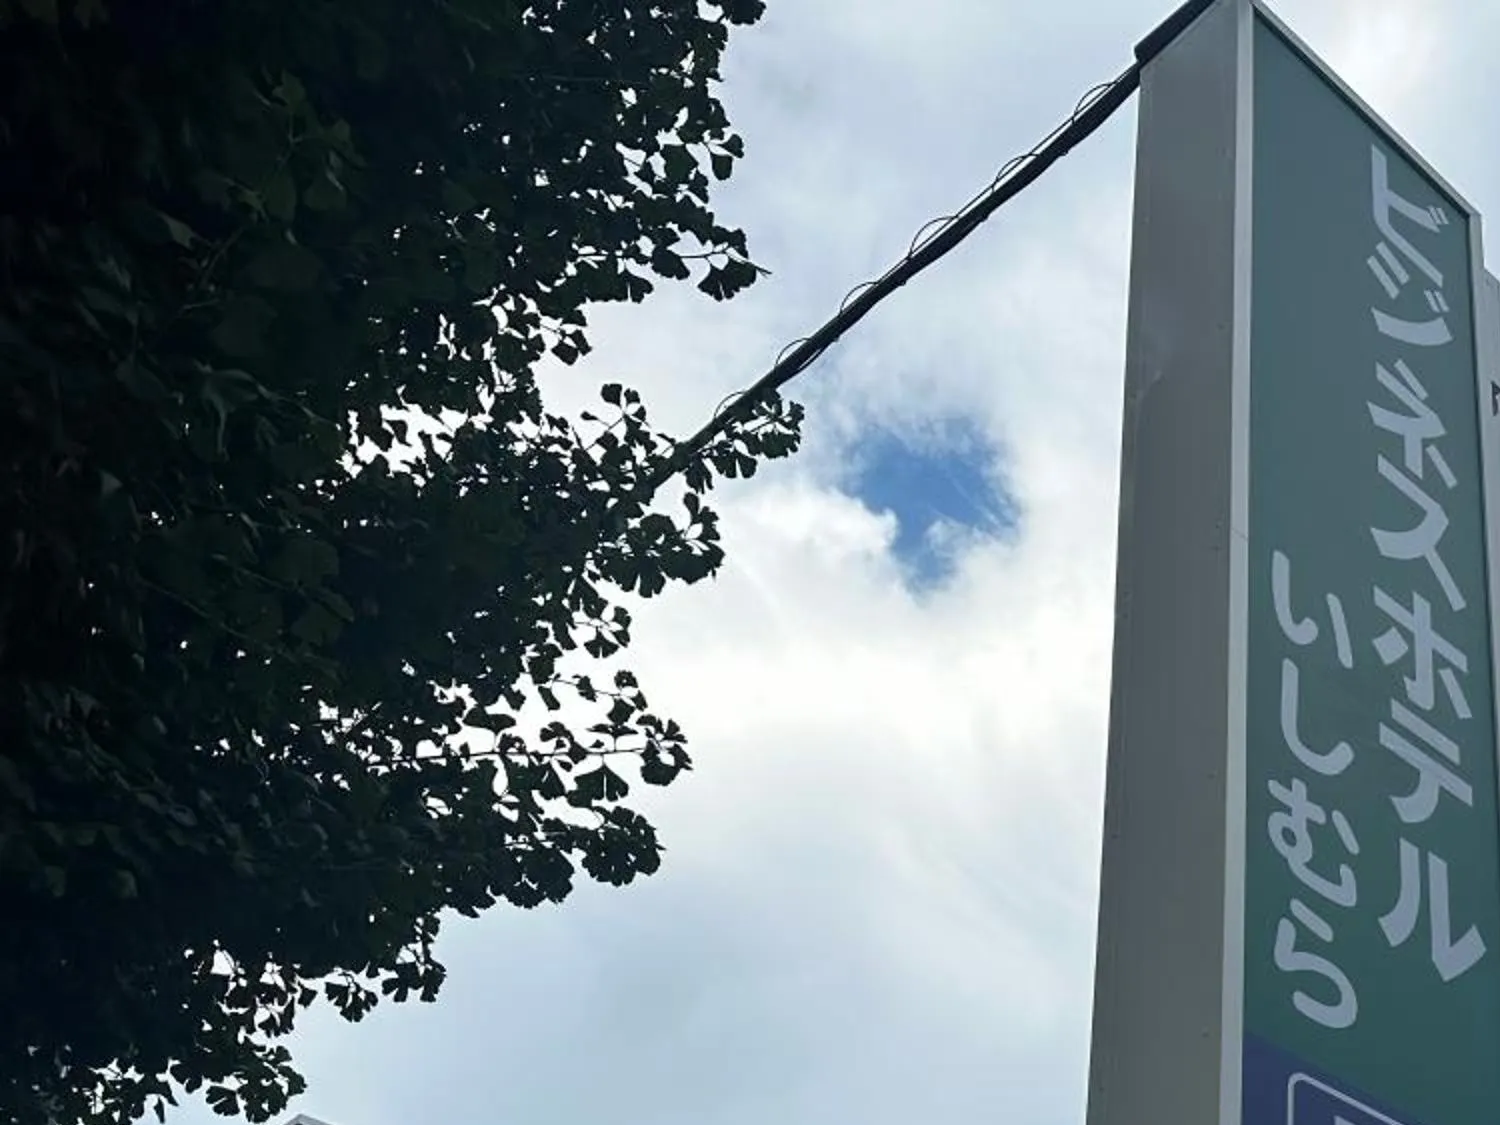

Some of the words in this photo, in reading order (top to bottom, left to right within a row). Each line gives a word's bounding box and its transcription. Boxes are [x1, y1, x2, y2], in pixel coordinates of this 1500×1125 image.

[1267, 550, 1360, 1029] いしむら
[1366, 144, 1487, 981] ビジネスホテル
